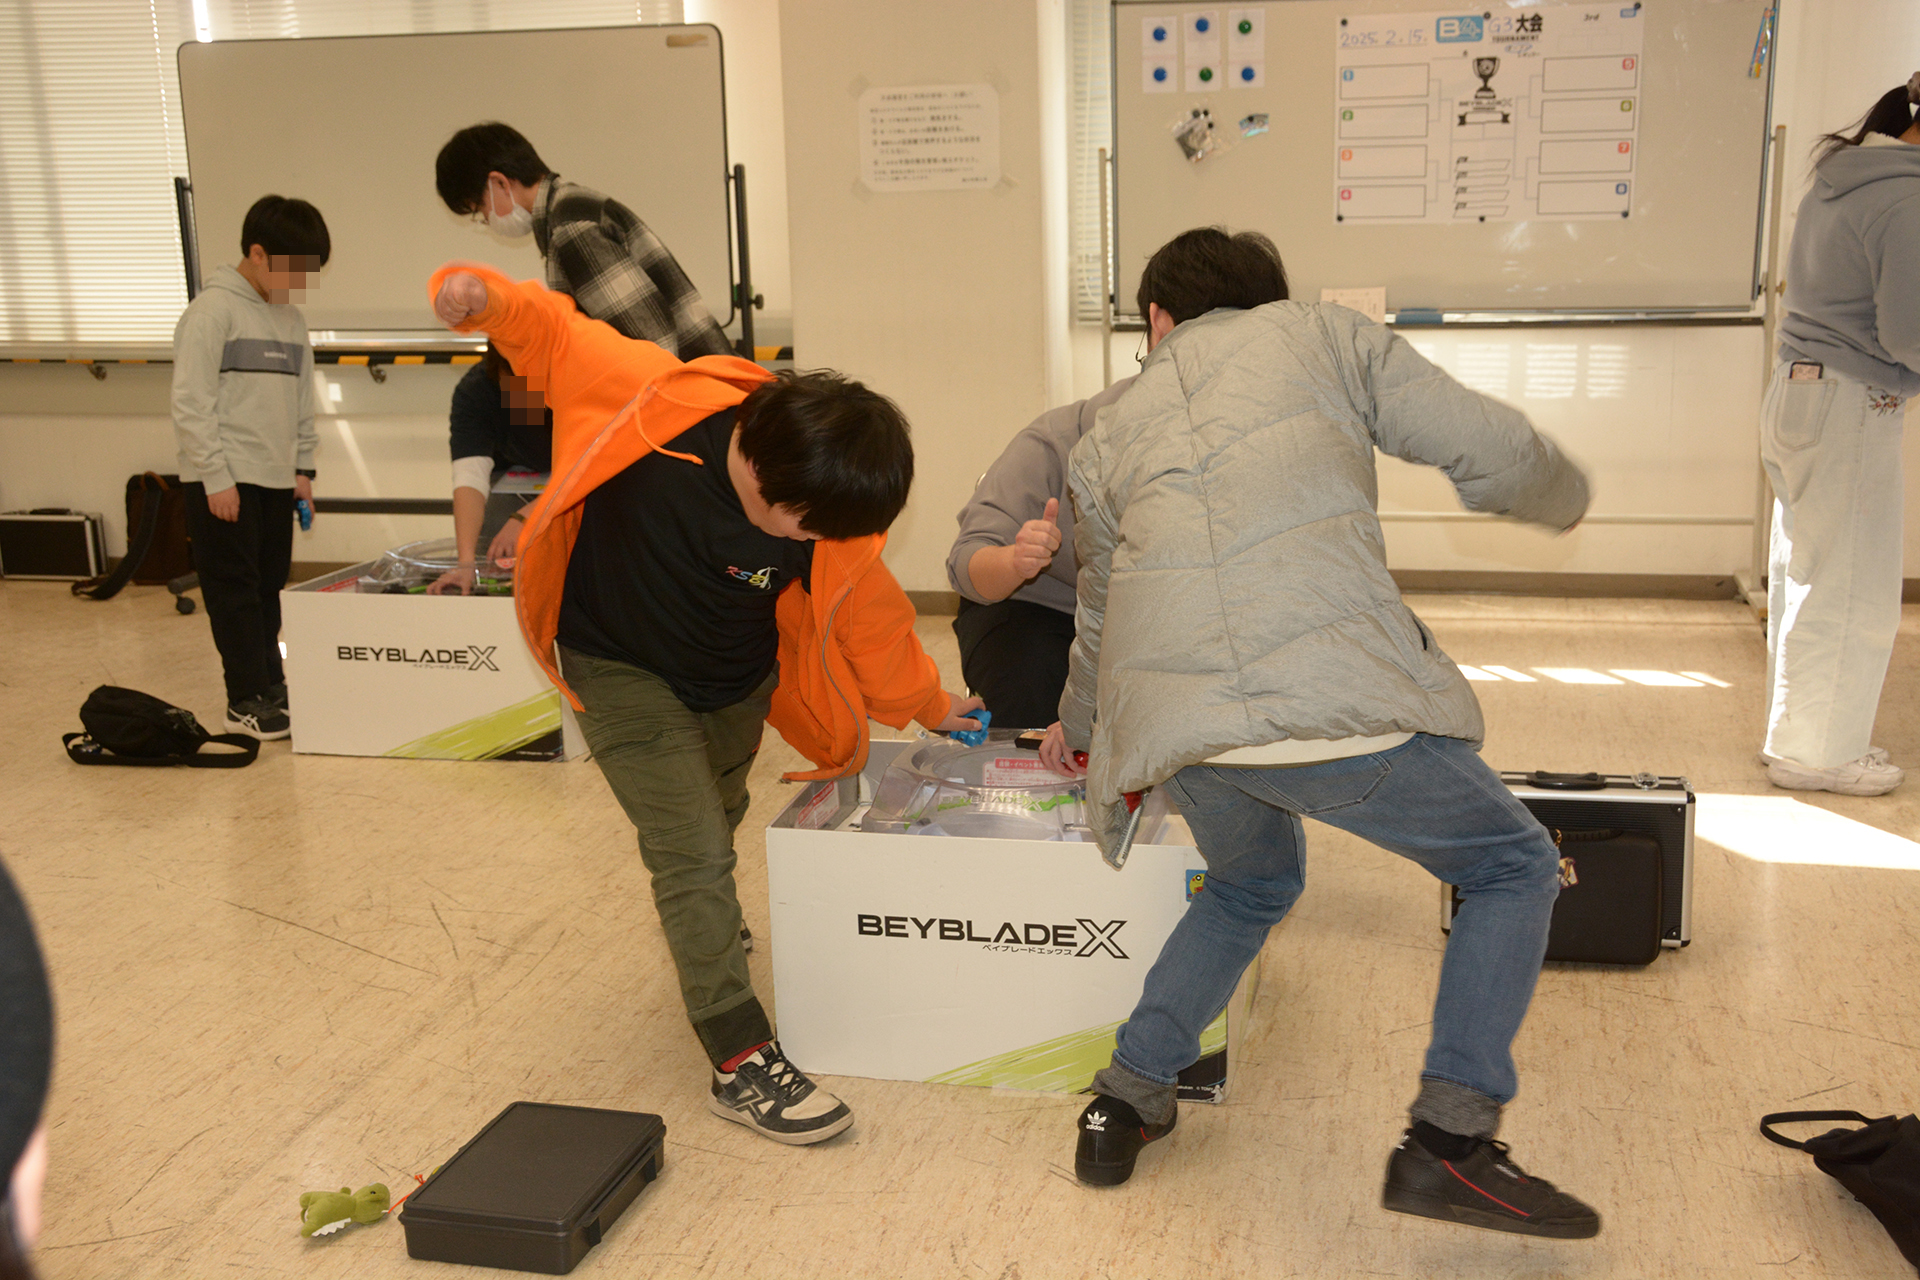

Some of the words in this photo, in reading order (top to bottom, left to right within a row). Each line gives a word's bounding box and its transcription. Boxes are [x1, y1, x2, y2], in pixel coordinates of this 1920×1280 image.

[1516, 13, 1544, 33] 大会
[1492, 34, 1540, 43] TOURNAMENT
[982, 944, 1073, 956] ベイブレードエックス
[1085, 1124, 1105, 1132] adidas
